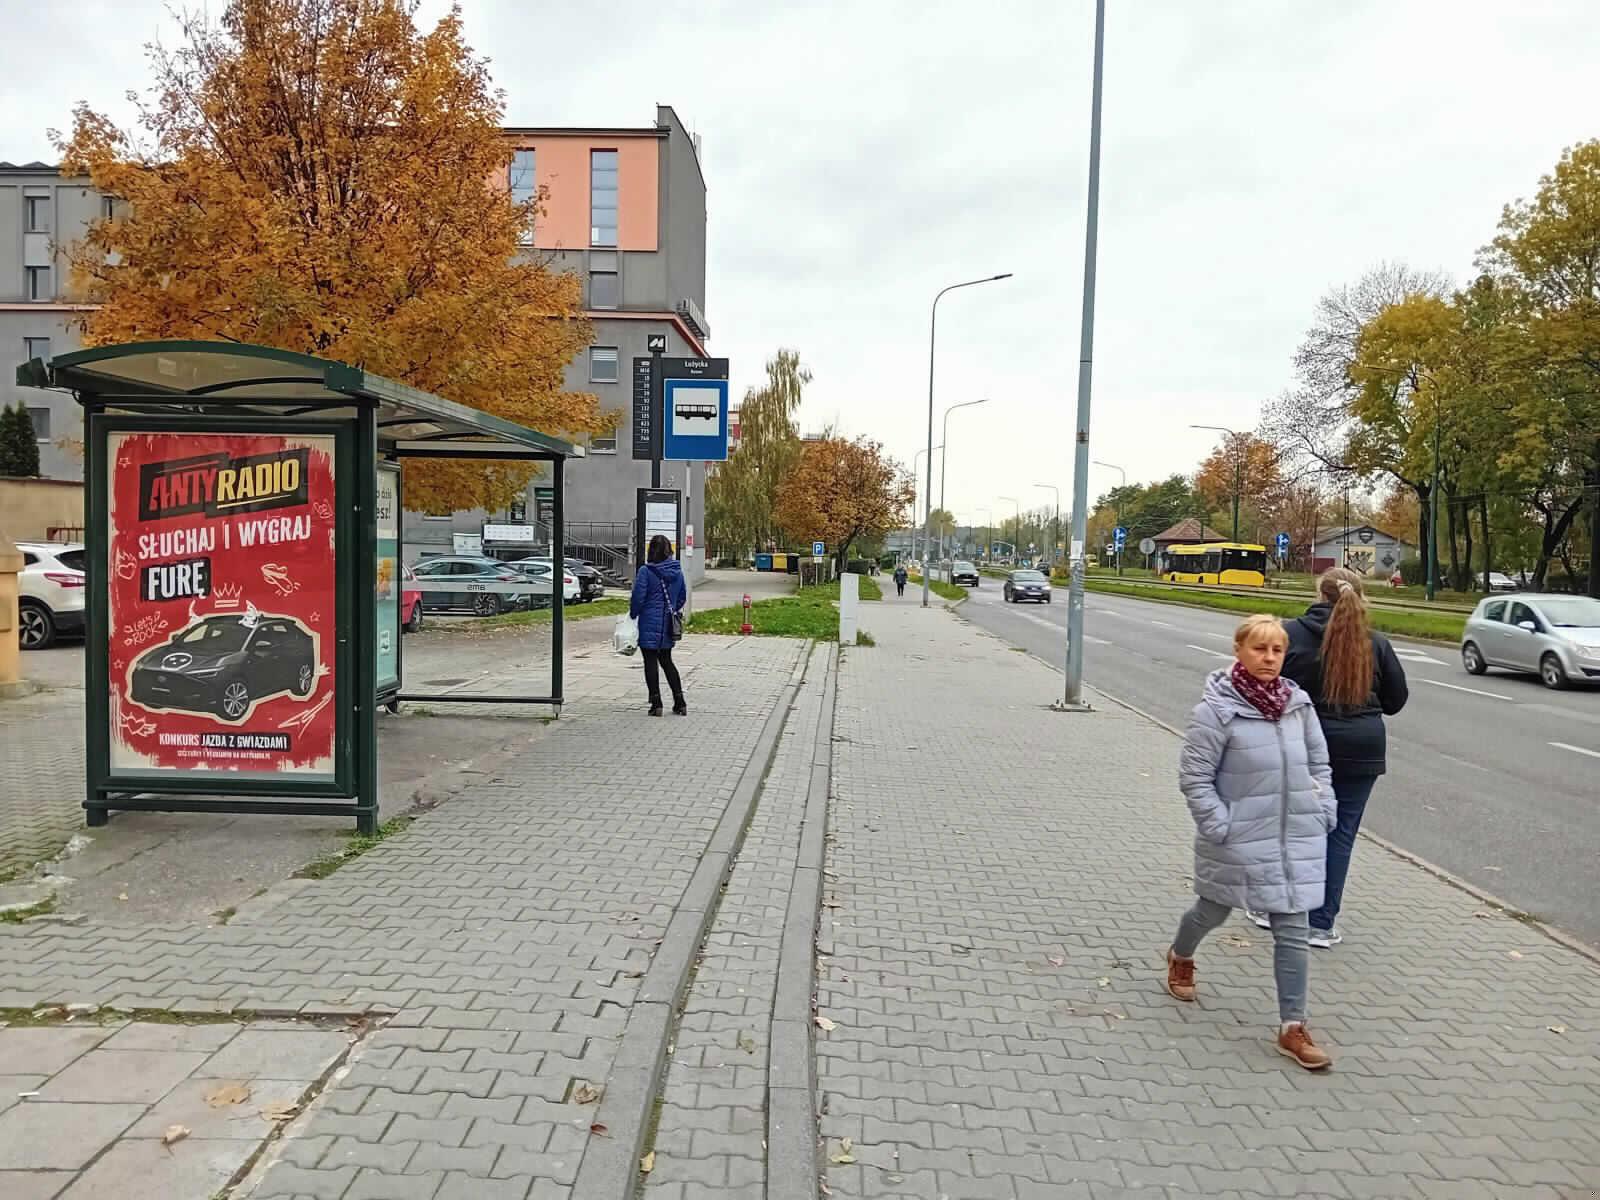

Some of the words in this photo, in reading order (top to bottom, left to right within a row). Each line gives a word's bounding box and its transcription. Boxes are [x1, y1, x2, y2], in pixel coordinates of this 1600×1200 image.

[150, 458, 299, 511] ANTYRADIO
[138, 526, 215, 560] SŁUCHAJ
[224, 522, 230, 550] I
[238, 516, 312, 547] WYGRAJ
[148, 561, 206, 600] FURĘ
[159, 734, 200, 747] KONKURS
[201, 734, 226, 748] JAZDA
[228, 735, 235, 748] Z
[237, 735, 288, 750] GWIAZDAMI
